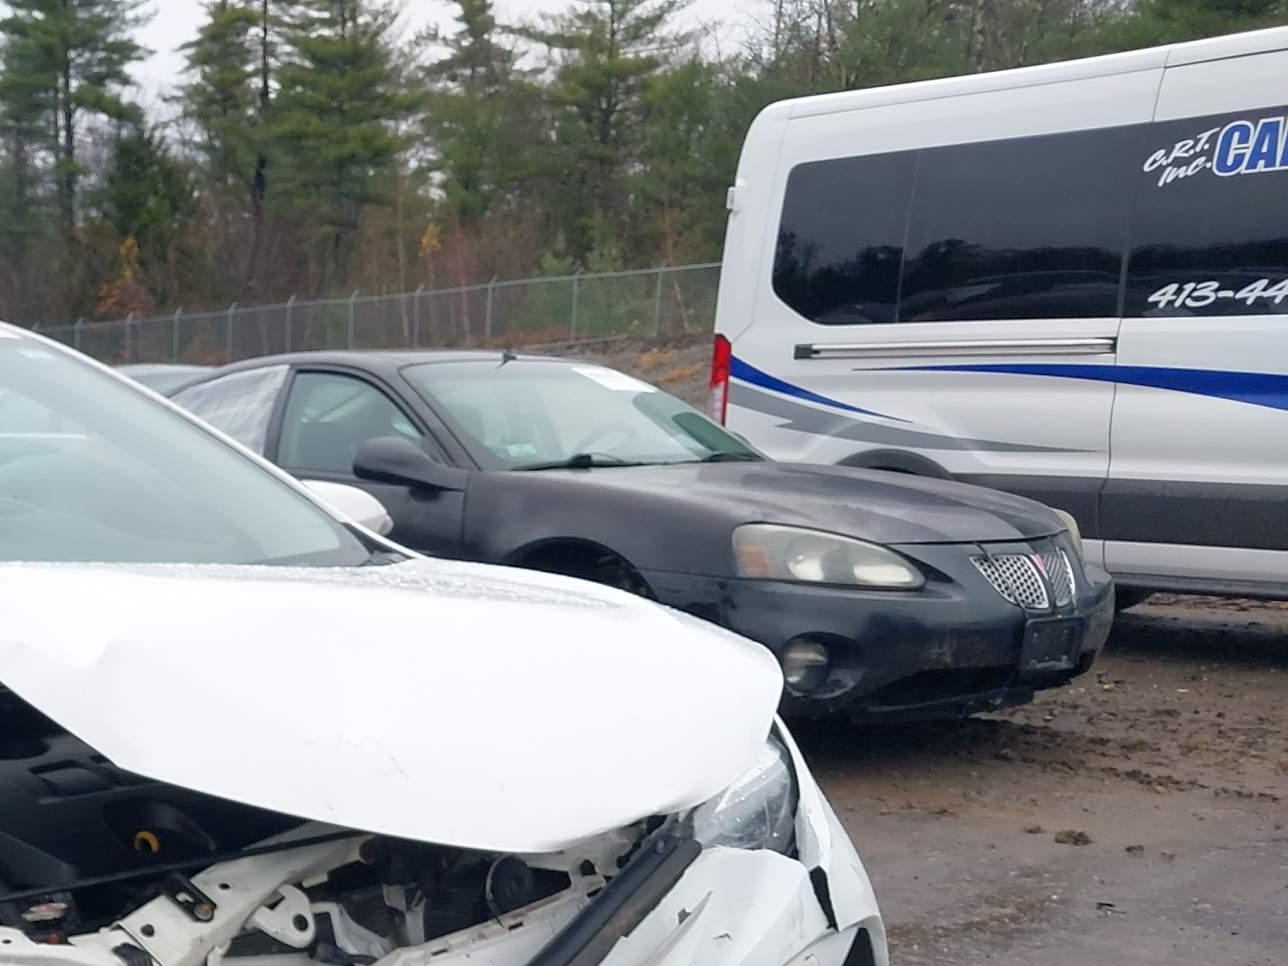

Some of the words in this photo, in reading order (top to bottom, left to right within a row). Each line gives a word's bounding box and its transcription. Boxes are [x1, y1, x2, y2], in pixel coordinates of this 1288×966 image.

[1143, 127, 1221, 172] C.R.T.
[1212, 116, 1288, 177] CA
[1157, 156, 1212, 187] Inc.
[1147, 278, 1288, 309] 413-44
